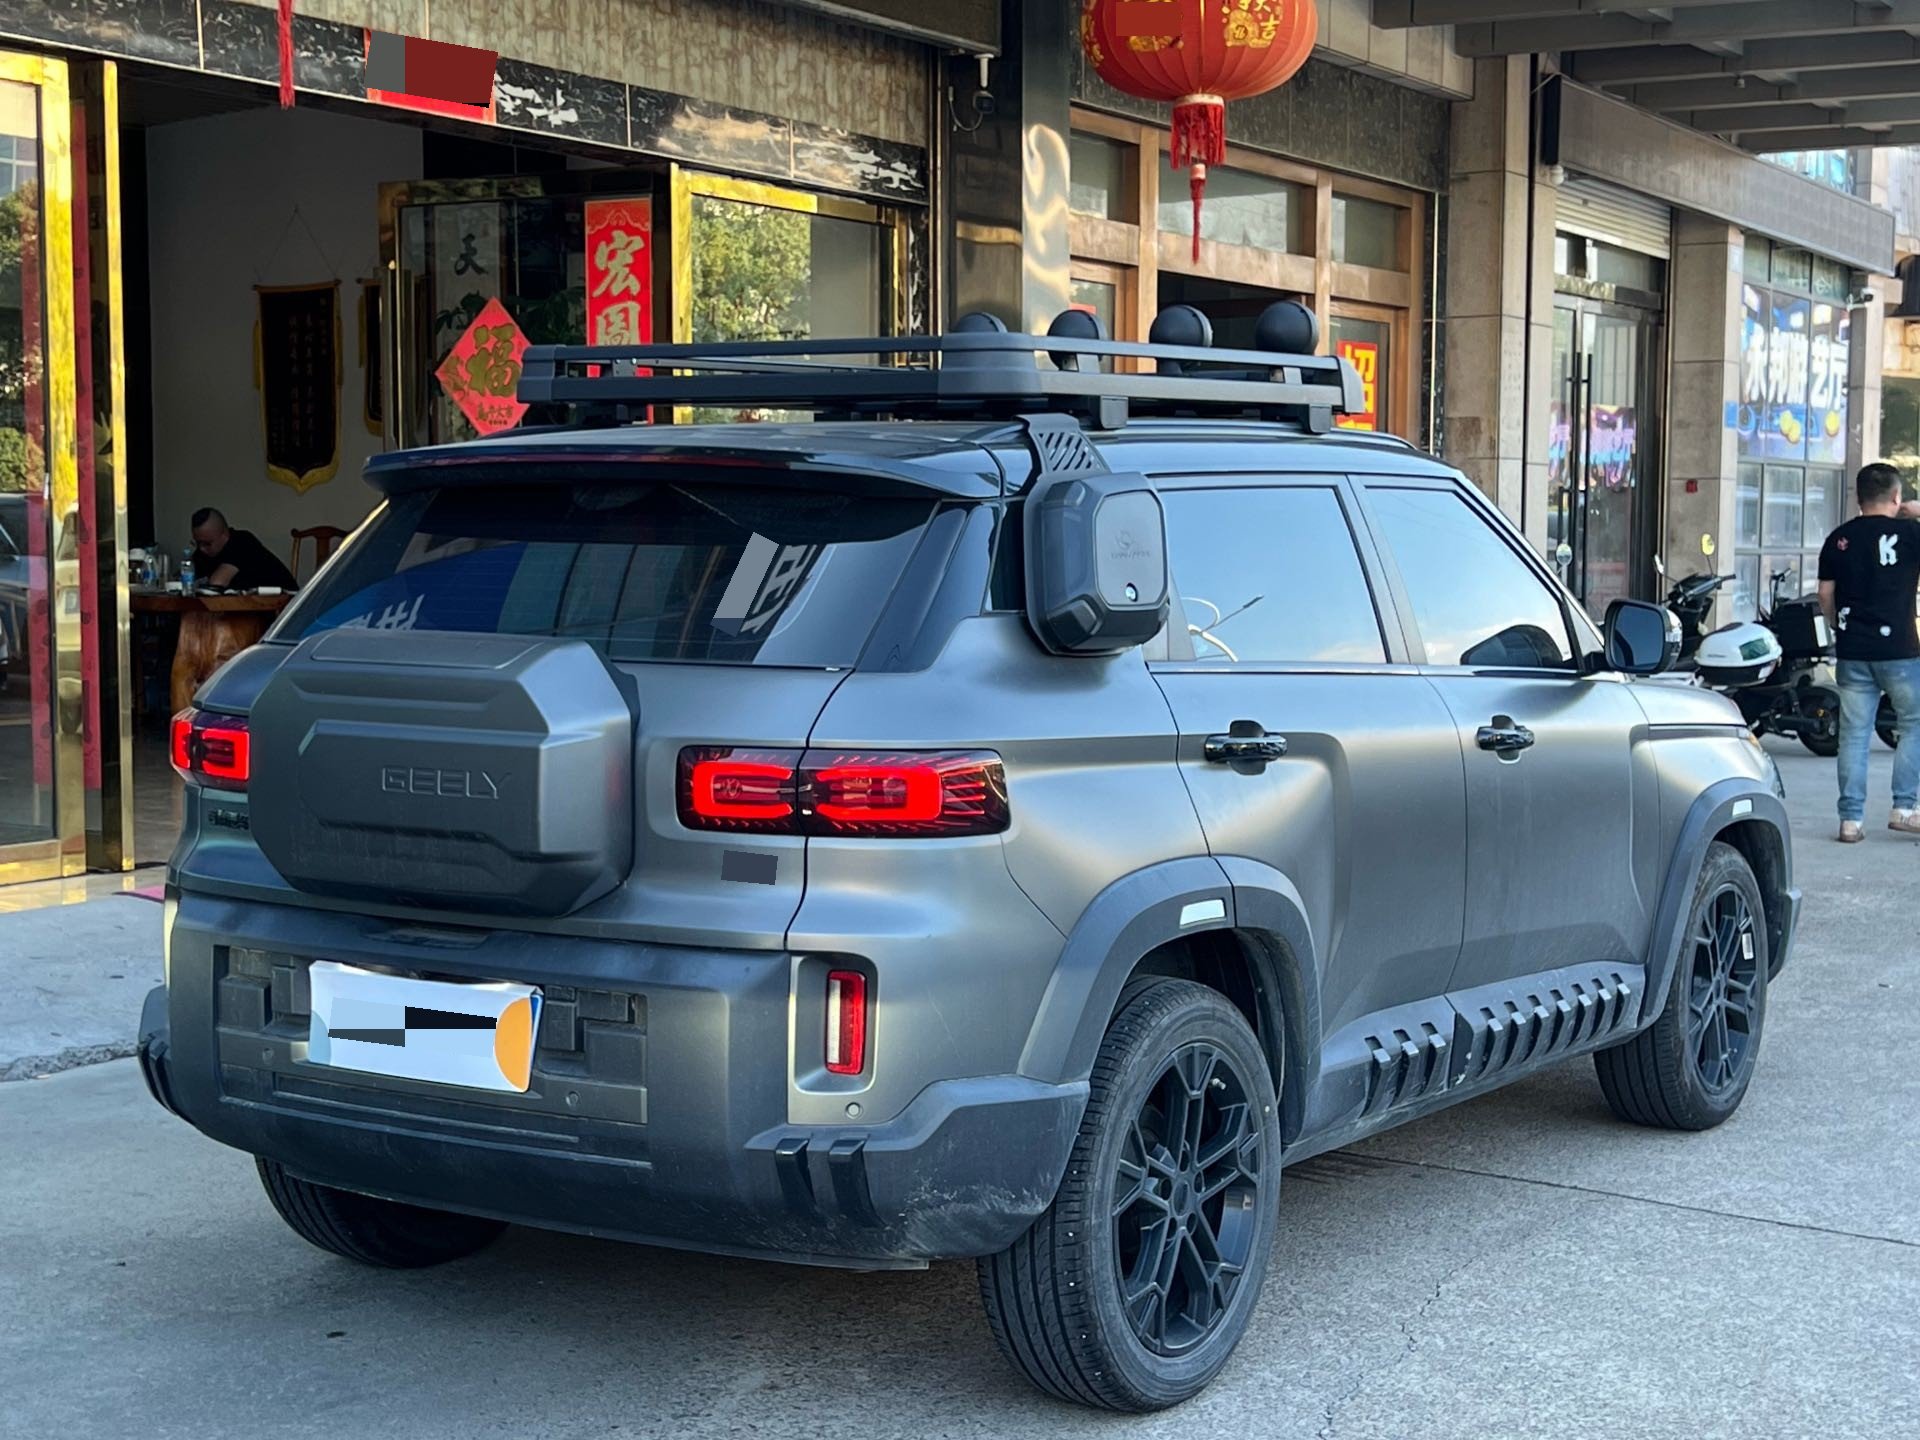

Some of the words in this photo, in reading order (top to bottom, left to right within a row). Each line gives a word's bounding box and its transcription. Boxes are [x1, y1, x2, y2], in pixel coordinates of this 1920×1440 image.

[466, 323, 521, 397] 福
[1879, 534, 1898, 566] K
[382, 767, 511, 799] GEELY
